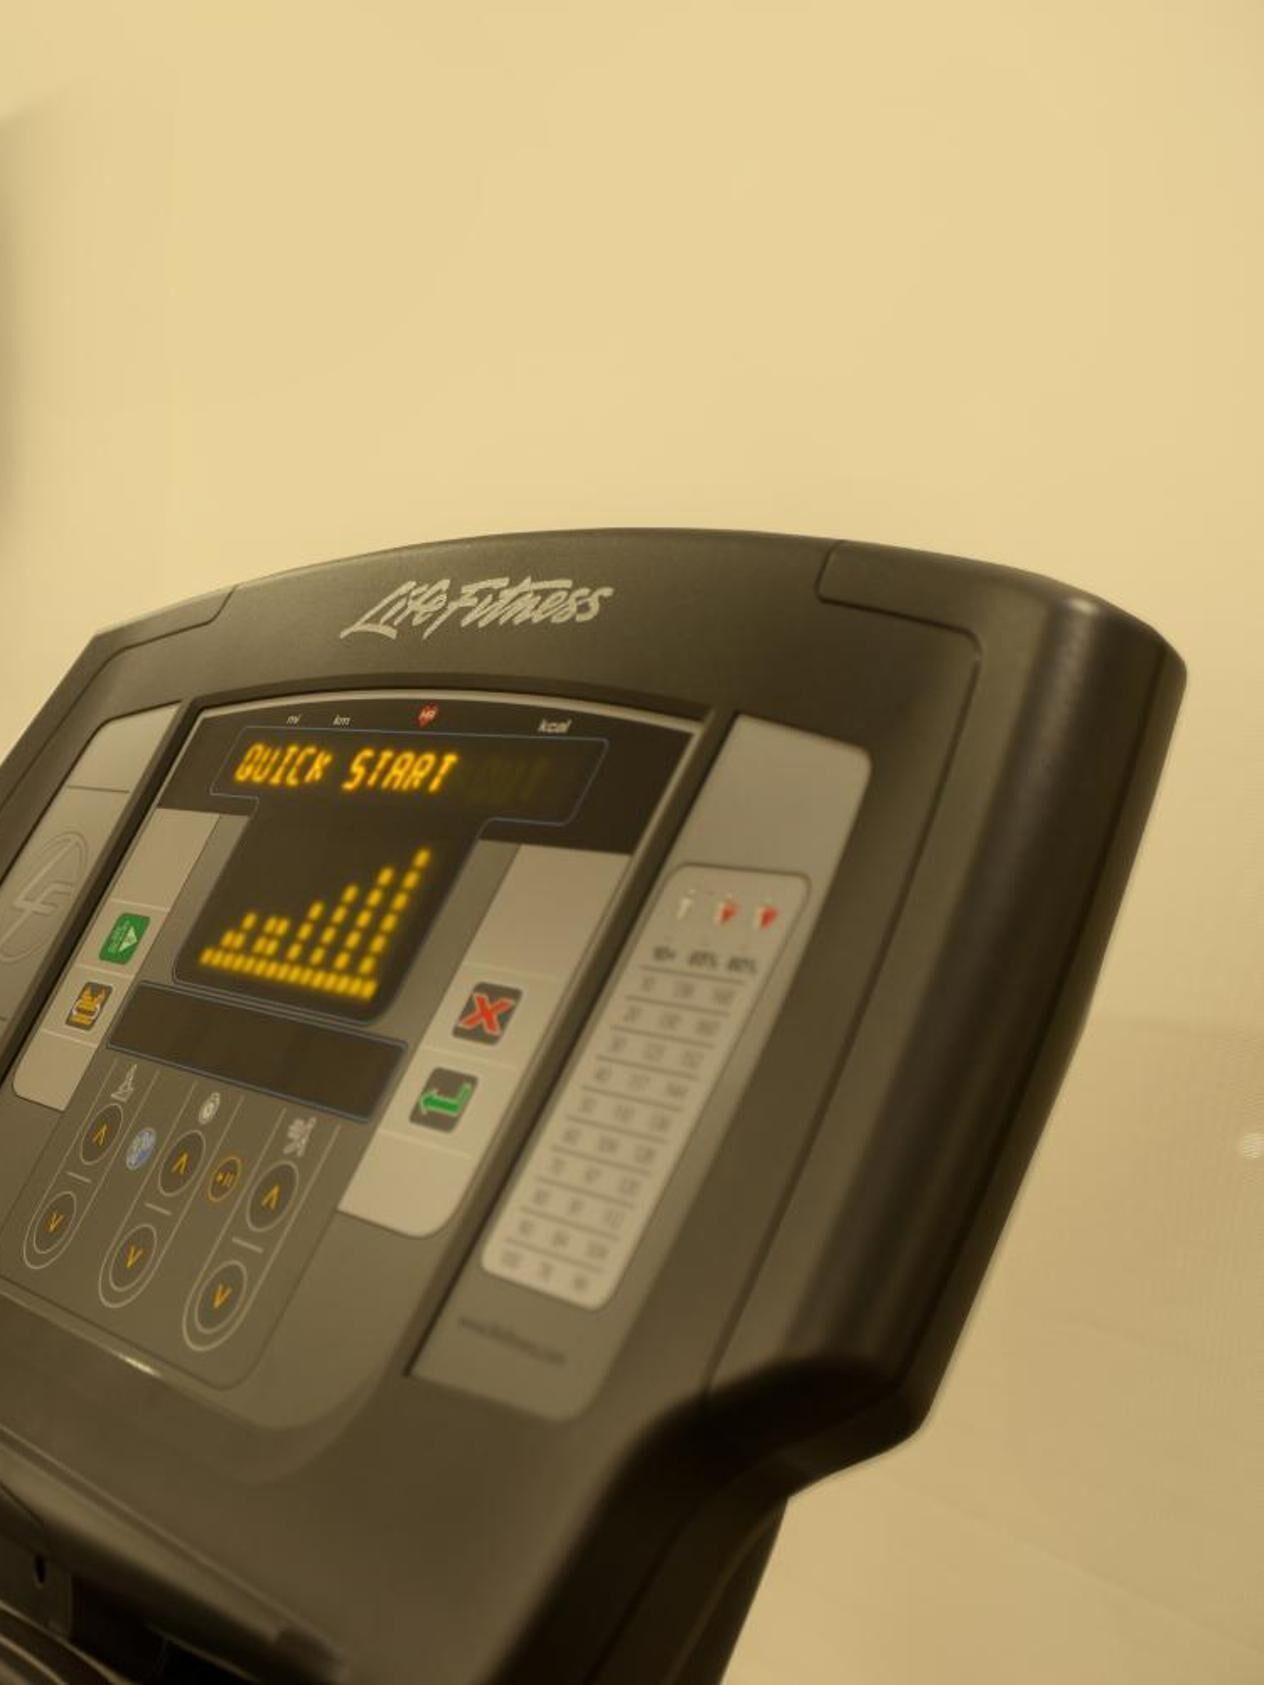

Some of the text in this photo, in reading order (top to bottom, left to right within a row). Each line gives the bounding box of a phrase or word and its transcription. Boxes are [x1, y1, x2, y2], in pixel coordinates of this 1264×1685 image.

[339, 576, 615, 640] Life Fitness
[333, 713, 351, 726] km
[538, 718, 573, 734] kcal
[234, 742, 333, 787] QUICK
[341, 747, 459, 792] START
